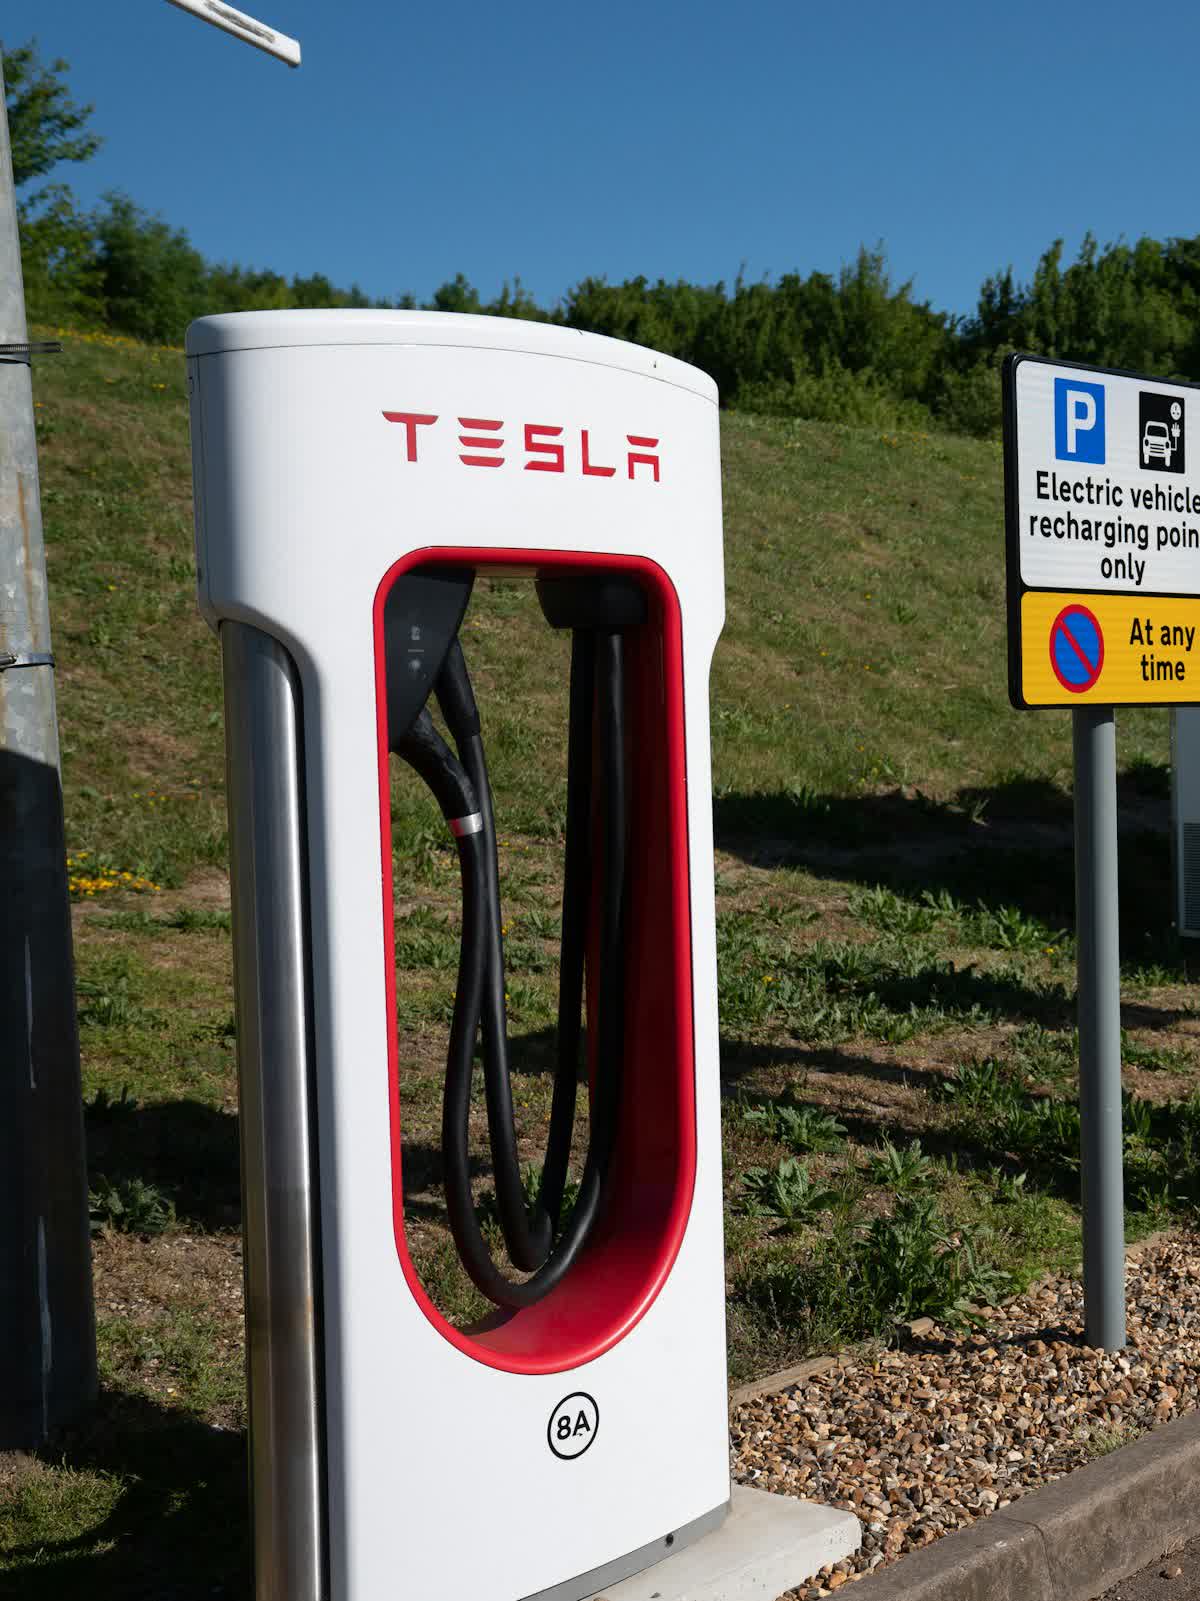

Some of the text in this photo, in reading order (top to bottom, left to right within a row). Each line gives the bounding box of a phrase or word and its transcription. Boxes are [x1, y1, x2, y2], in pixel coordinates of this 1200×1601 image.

[1066, 389, 1097, 454] P
[381, 410, 660, 483] TESLA
[1036, 470, 1123, 507] Electric
[1029, 511, 1148, 551] recharging
[1100, 552, 1145, 586] only
[1130, 617, 1195, 652] At any
[1140, 654, 1186, 681] time
[557, 1410, 591, 1440] 8A
